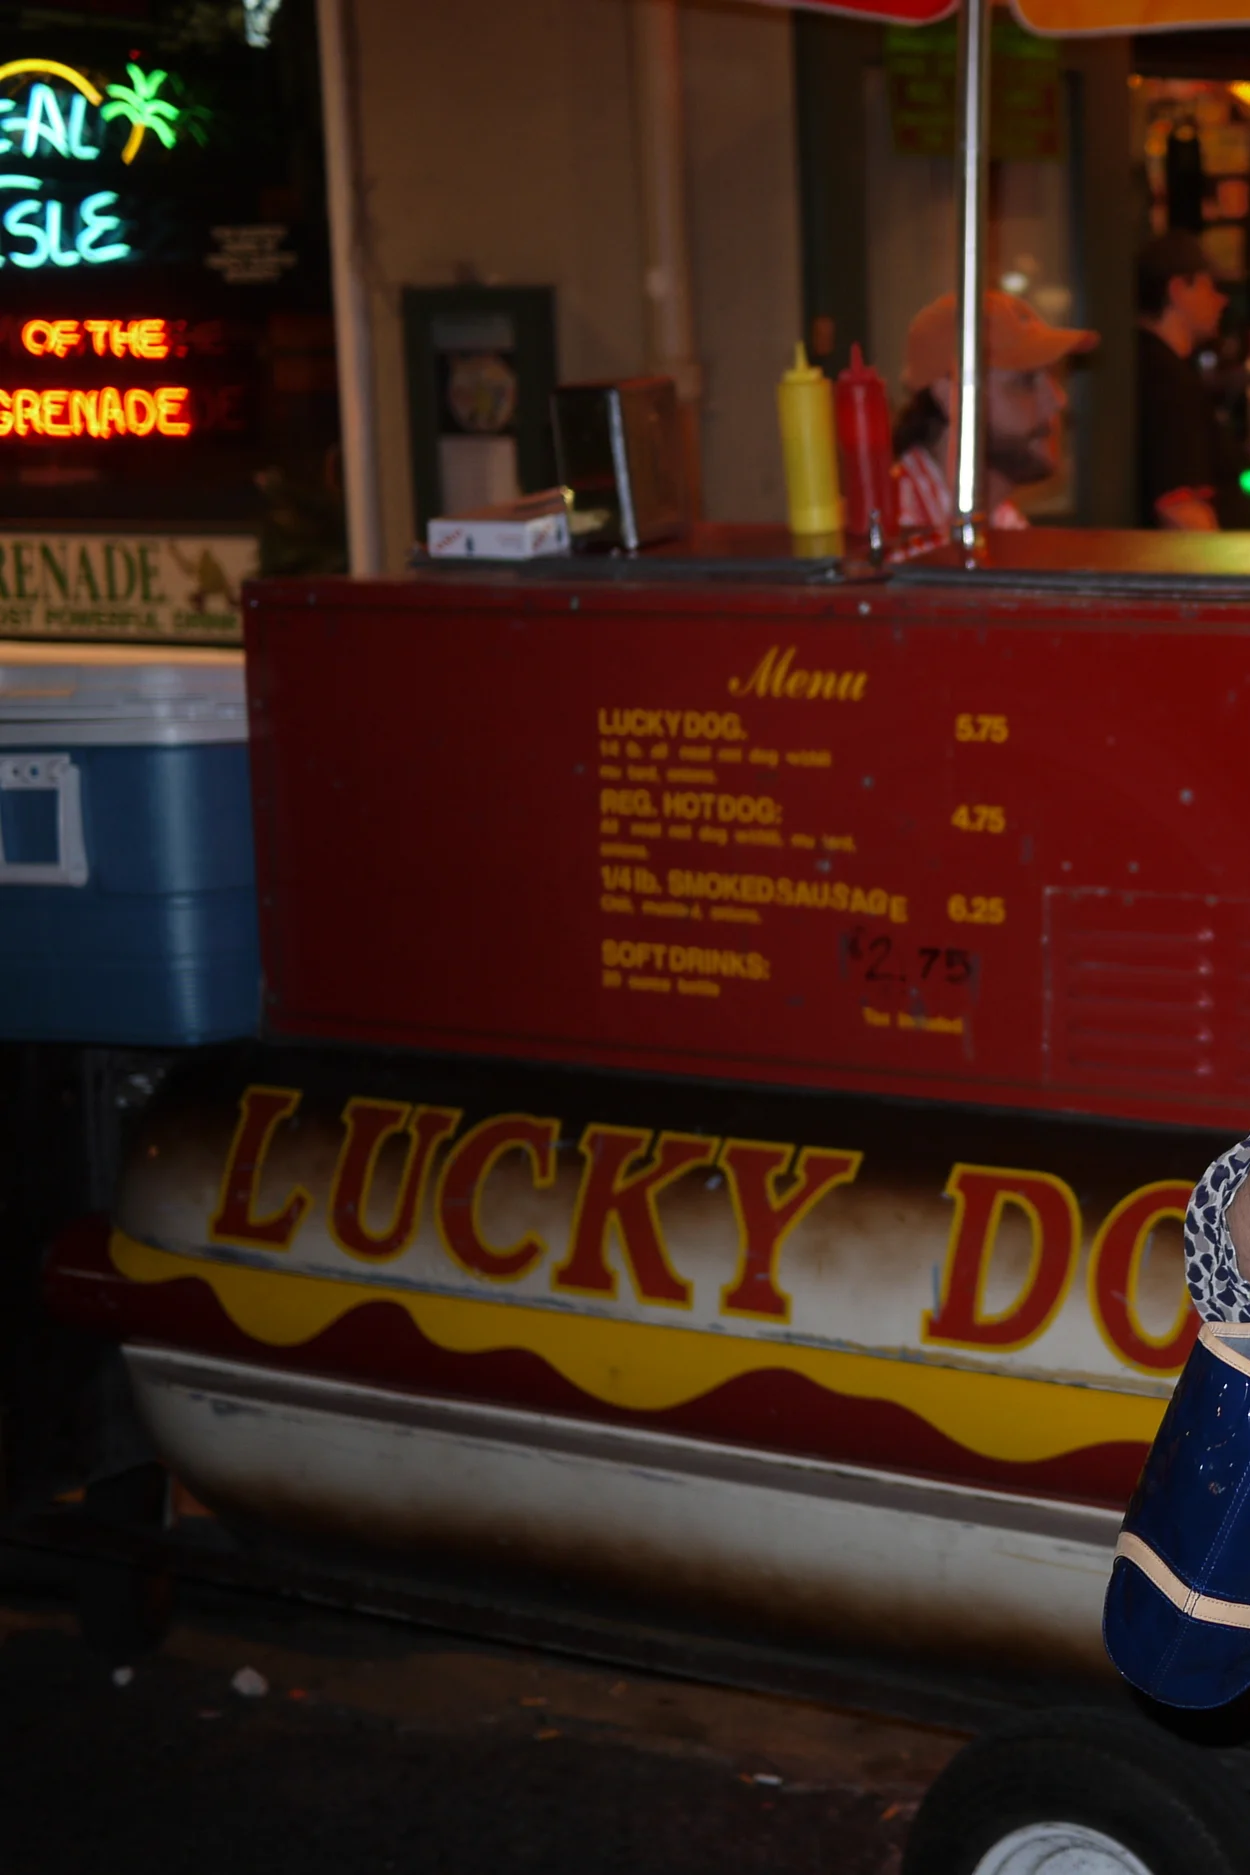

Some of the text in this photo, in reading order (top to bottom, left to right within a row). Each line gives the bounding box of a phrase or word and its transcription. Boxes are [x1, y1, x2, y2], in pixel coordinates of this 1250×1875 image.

[22, 319, 169, 359] OF THE
[727, 644, 868, 701] Menu
[954, 713, 1009, 744] 5.75
[950, 804, 1006, 834] 4.75
[947, 893, 1006, 924] 6.25
[208, 1084, 864, 1324] LUCKY
